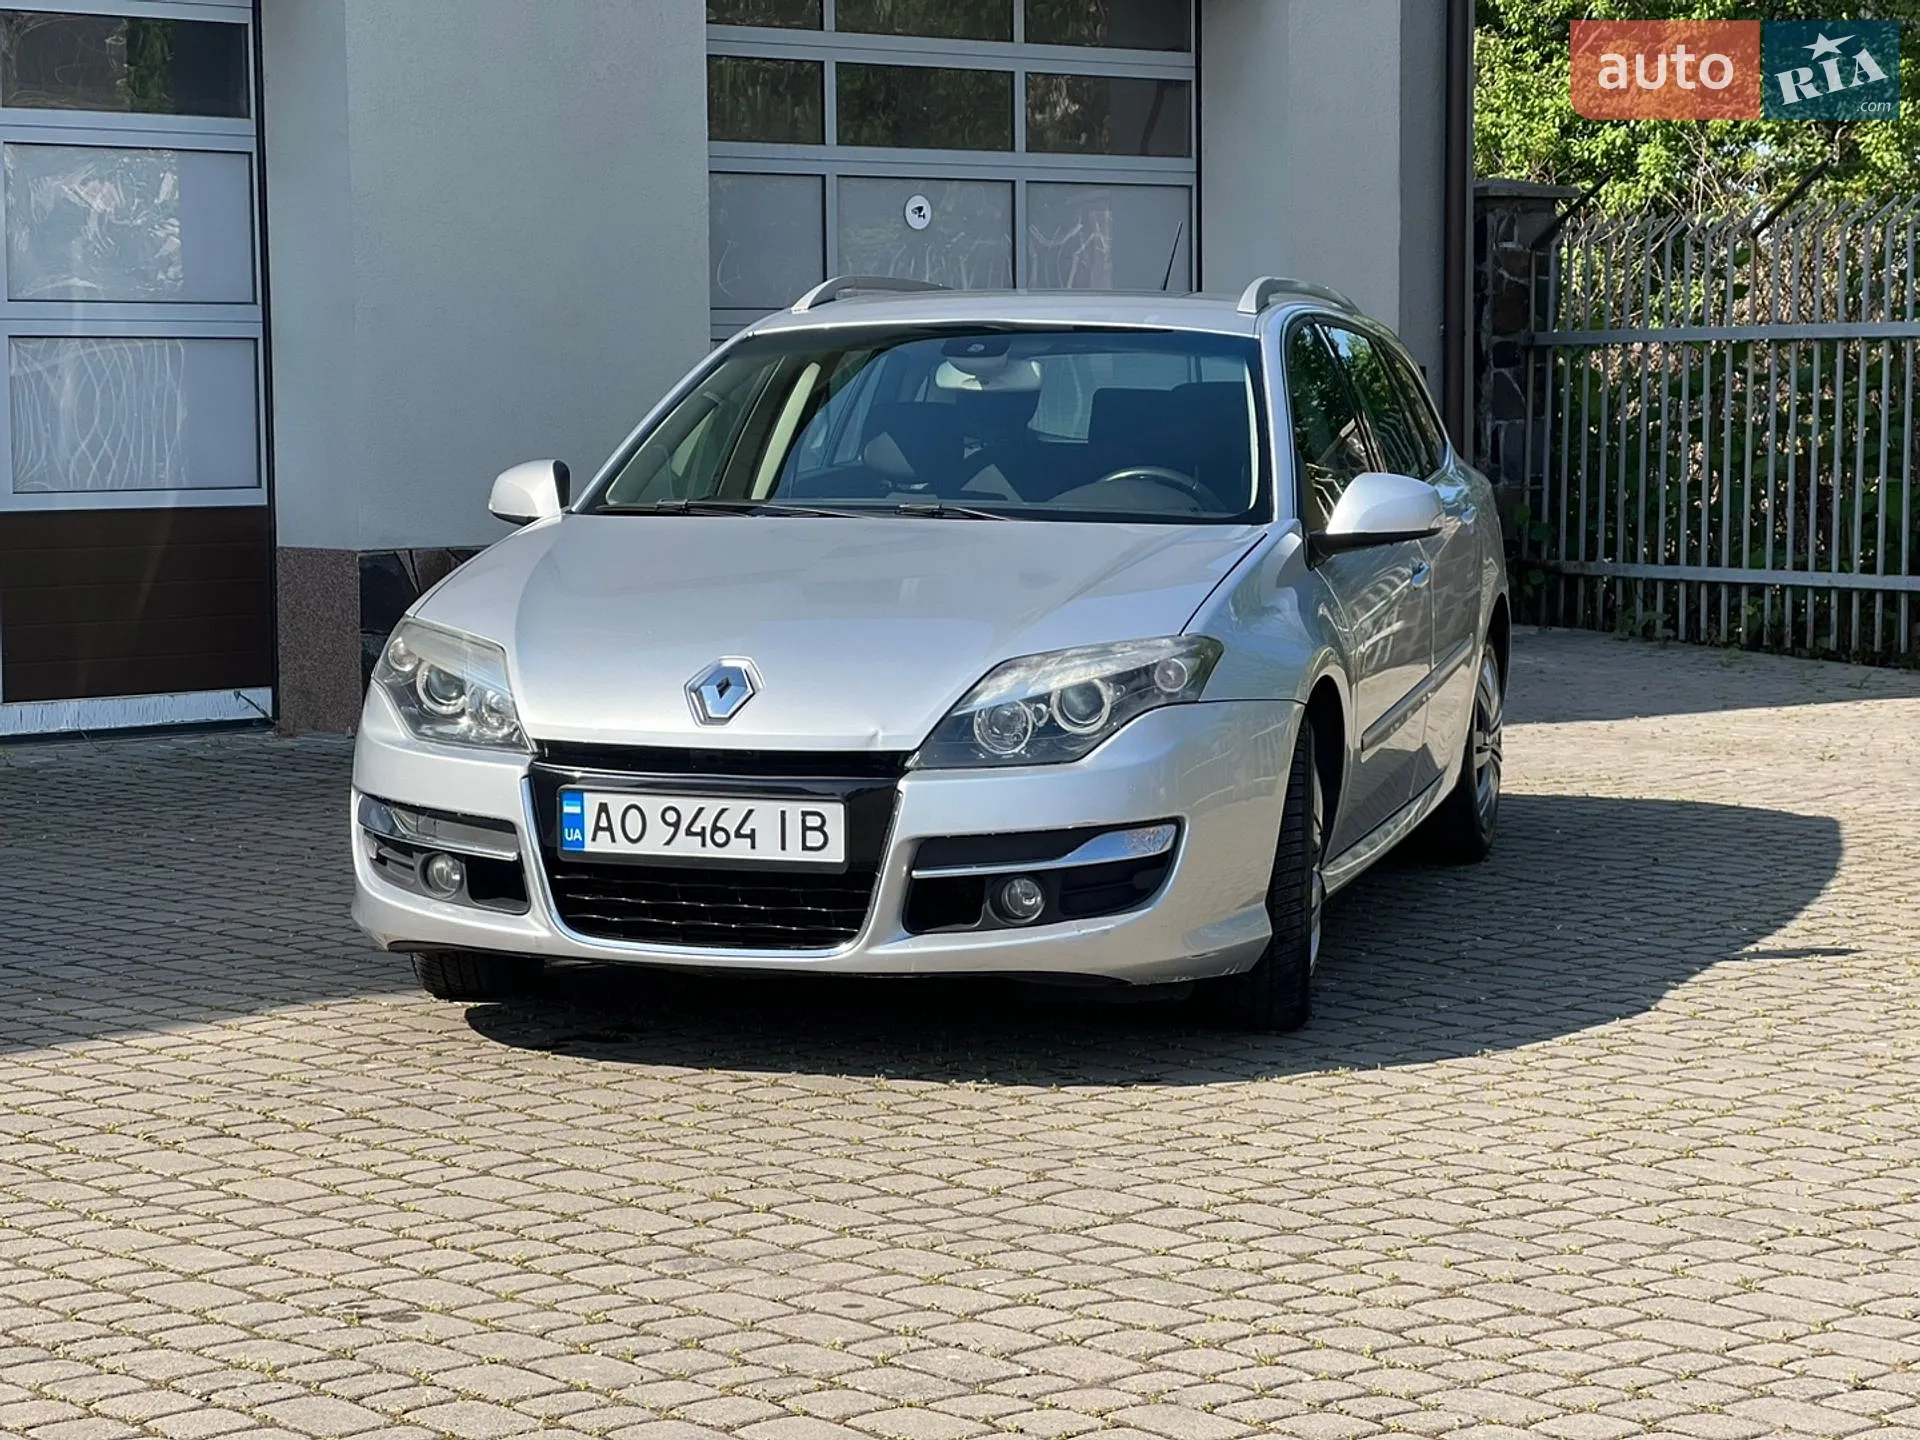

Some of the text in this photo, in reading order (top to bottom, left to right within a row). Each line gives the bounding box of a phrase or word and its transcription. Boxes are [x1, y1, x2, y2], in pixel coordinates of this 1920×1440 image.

[564, 828, 583, 842] UA
[591, 801, 829, 852] AO 9464 IB
